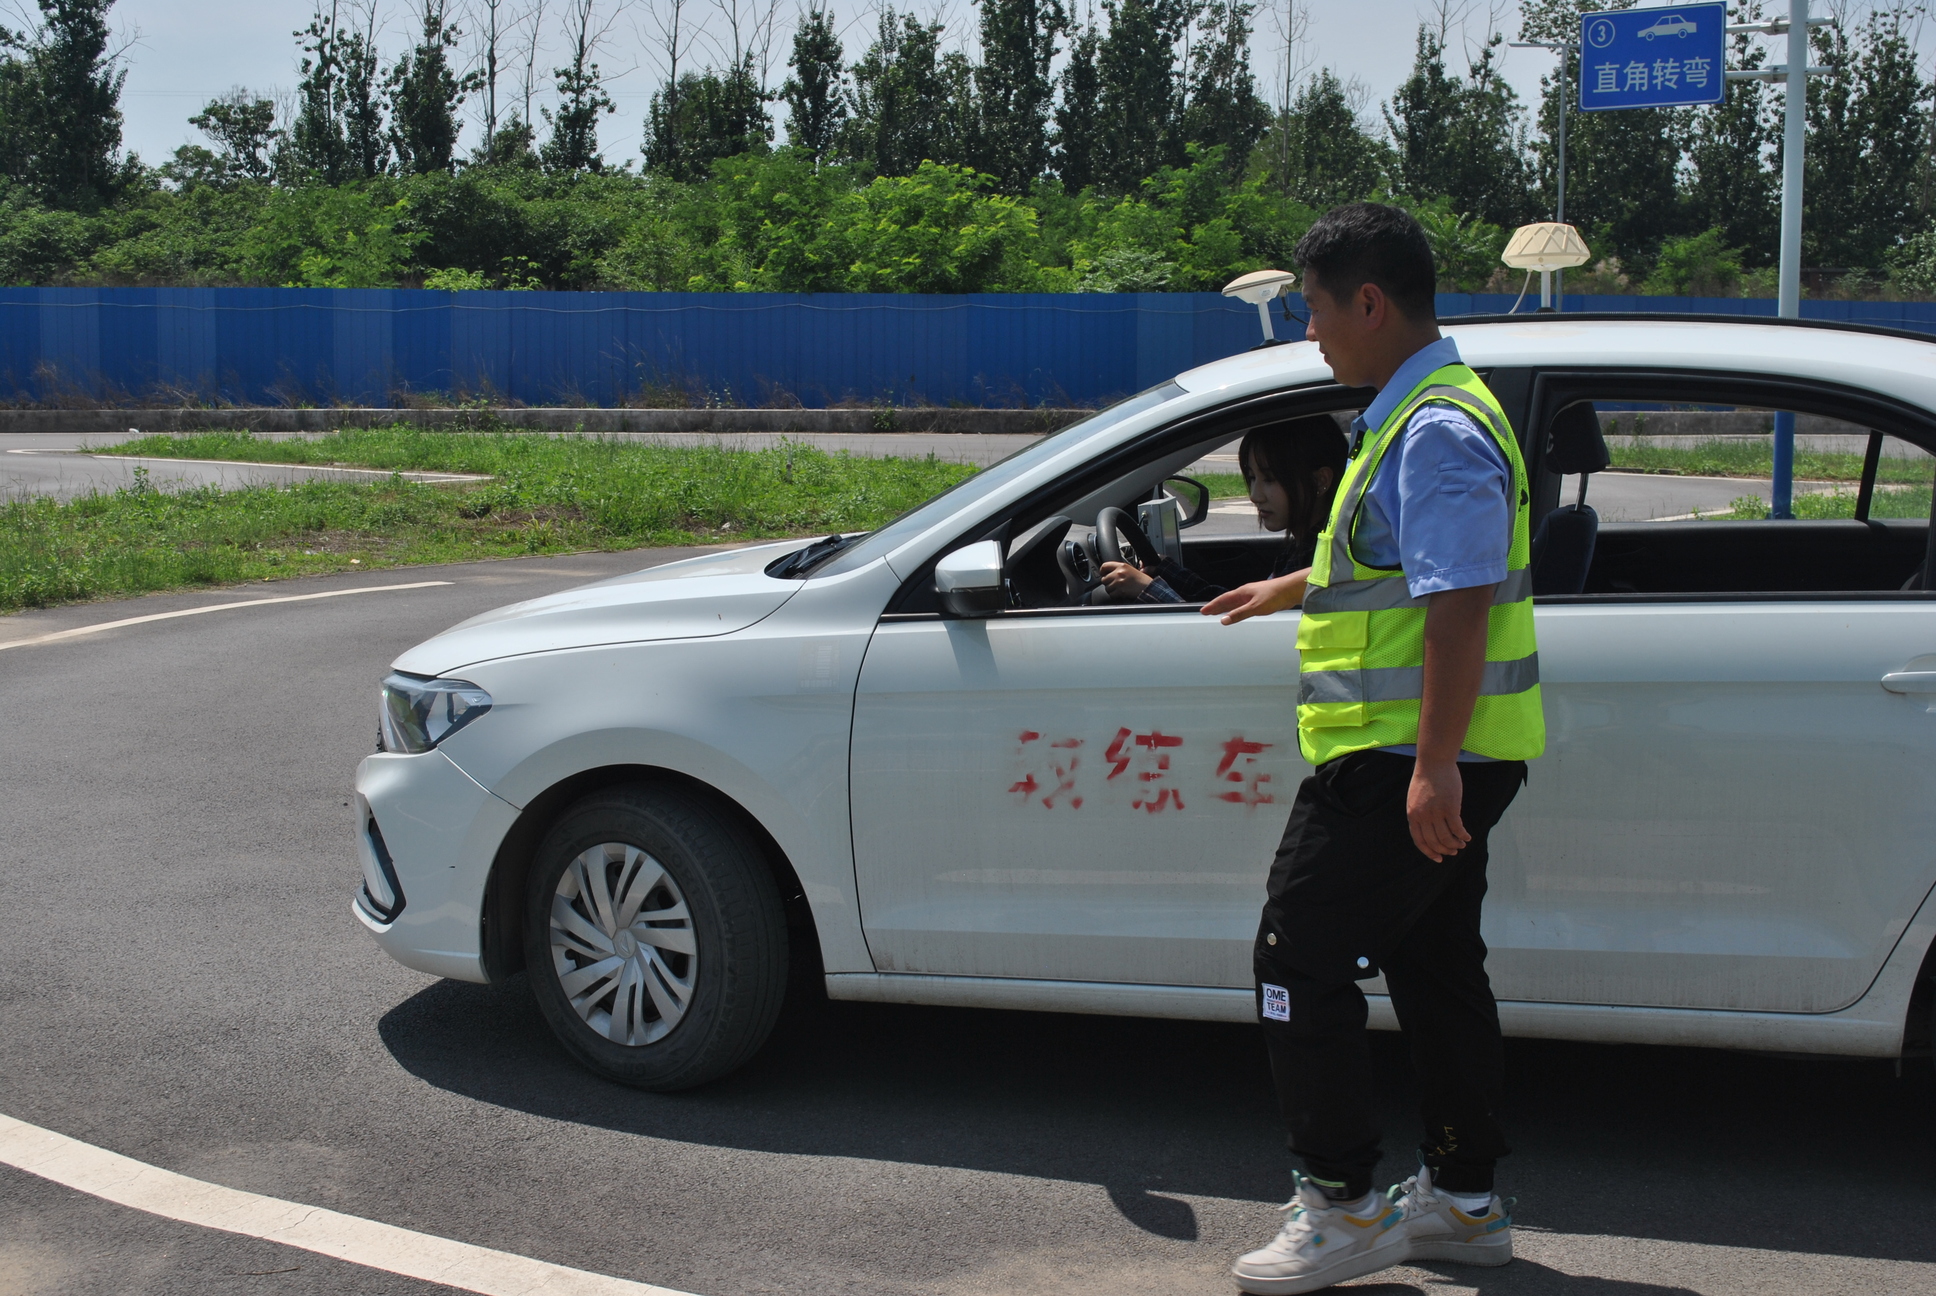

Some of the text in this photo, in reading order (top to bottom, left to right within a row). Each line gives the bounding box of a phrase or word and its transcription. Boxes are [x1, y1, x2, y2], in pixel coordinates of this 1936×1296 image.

[1592, 56, 1711, 94] 直角转弯
[1266, 988, 1287, 1002] OME
[1266, 1002, 1287, 1014] TEAM
